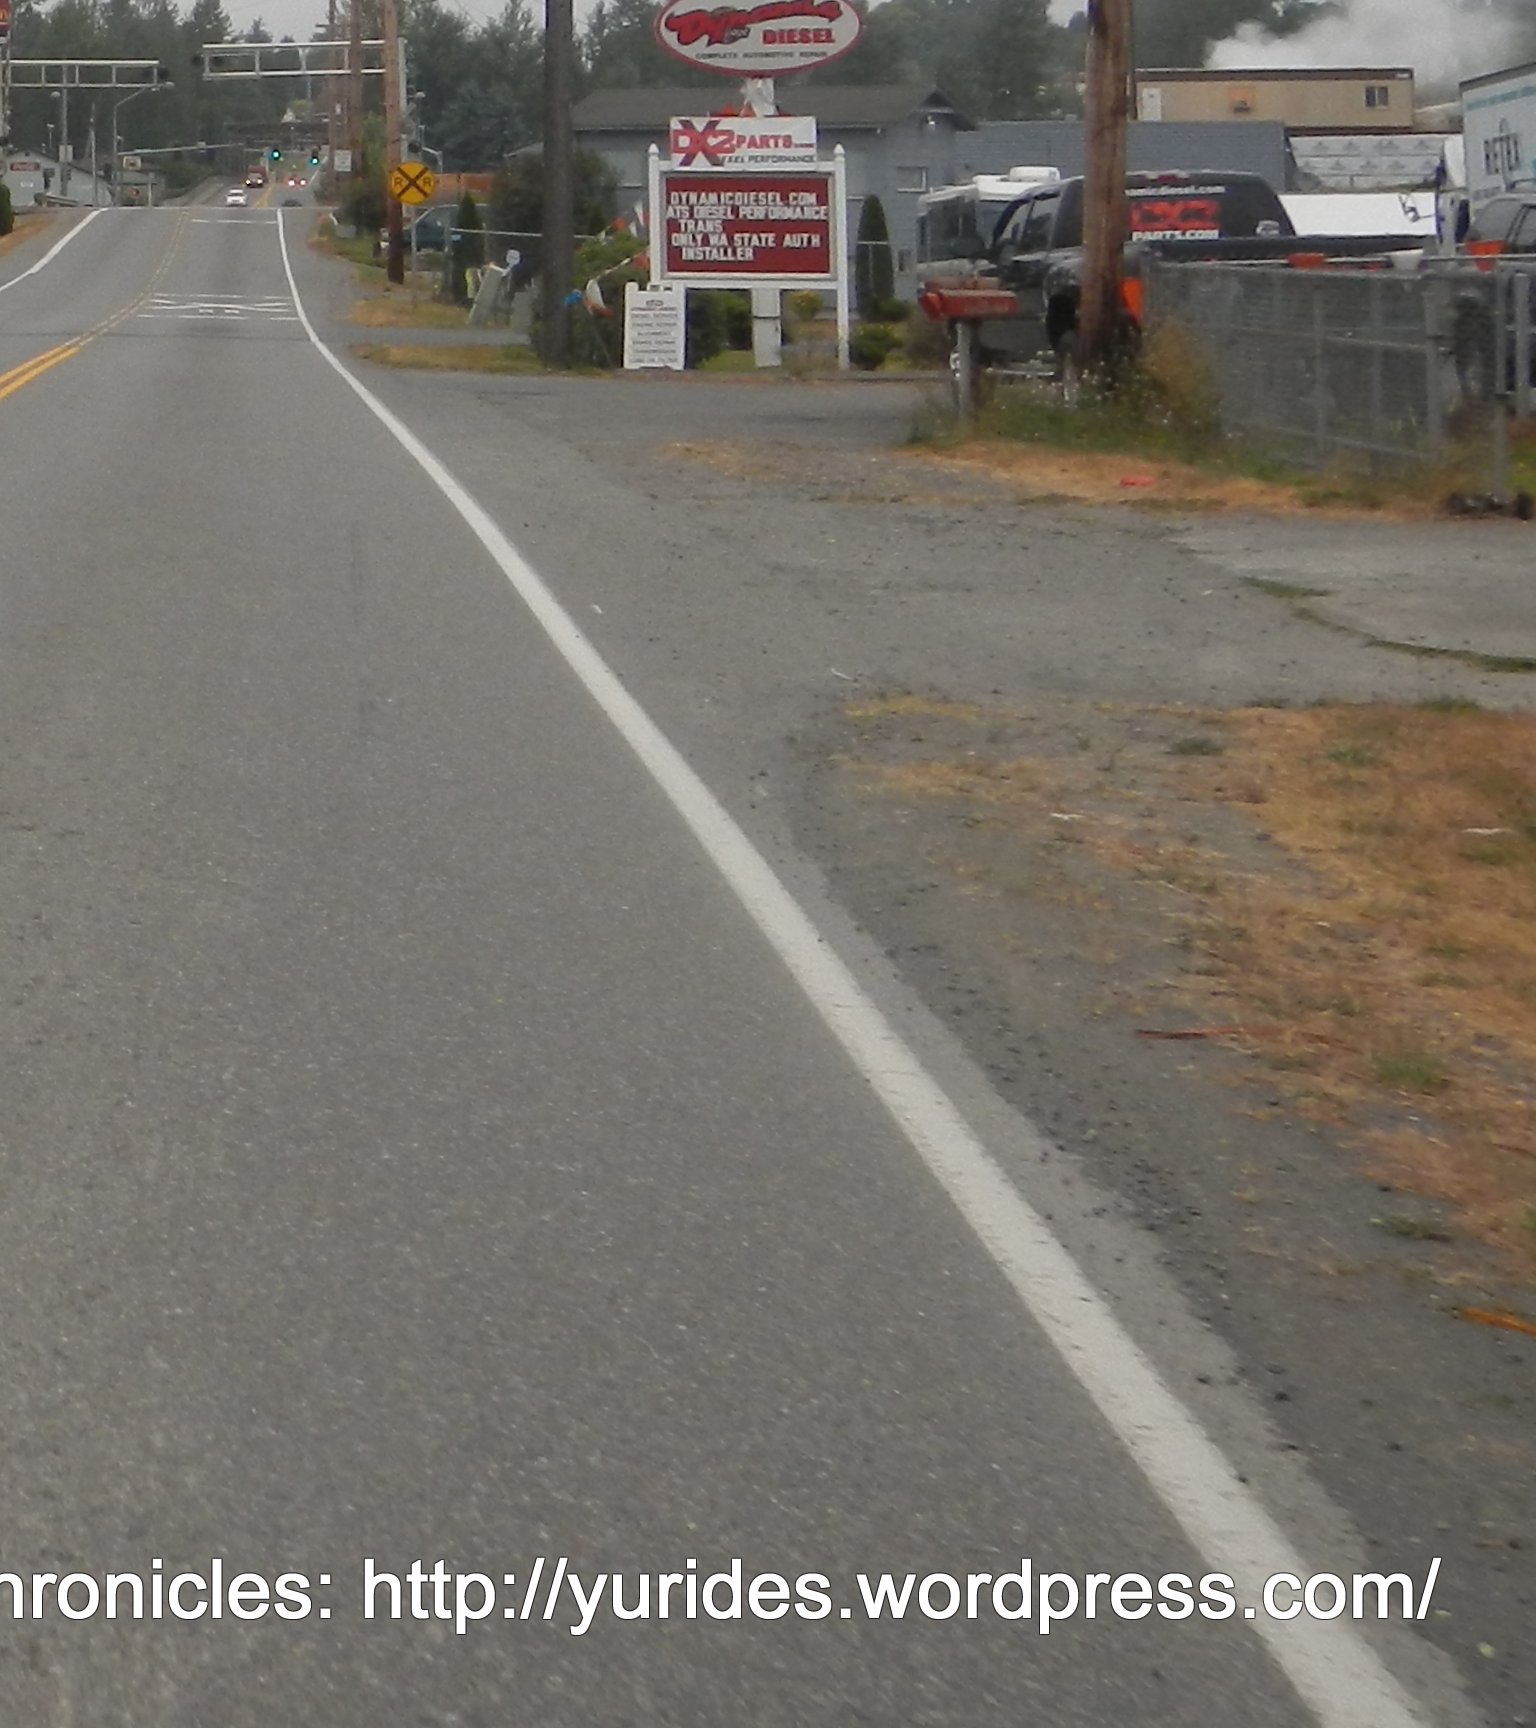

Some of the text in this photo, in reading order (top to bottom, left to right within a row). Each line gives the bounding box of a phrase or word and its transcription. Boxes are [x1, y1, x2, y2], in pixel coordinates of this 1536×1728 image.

[762, 28, 836, 45] DIESEL
[394, 177, 402, 187] R
[423, 178, 431, 187] R
[666, 206, 828, 219] ATS DIESEL PERFORMANCE
[680, 220, 723, 233] TRANS
[671, 233, 821, 247] ONLY WA STATE AUTH
[682, 247, 754, 260] INSTALLER
